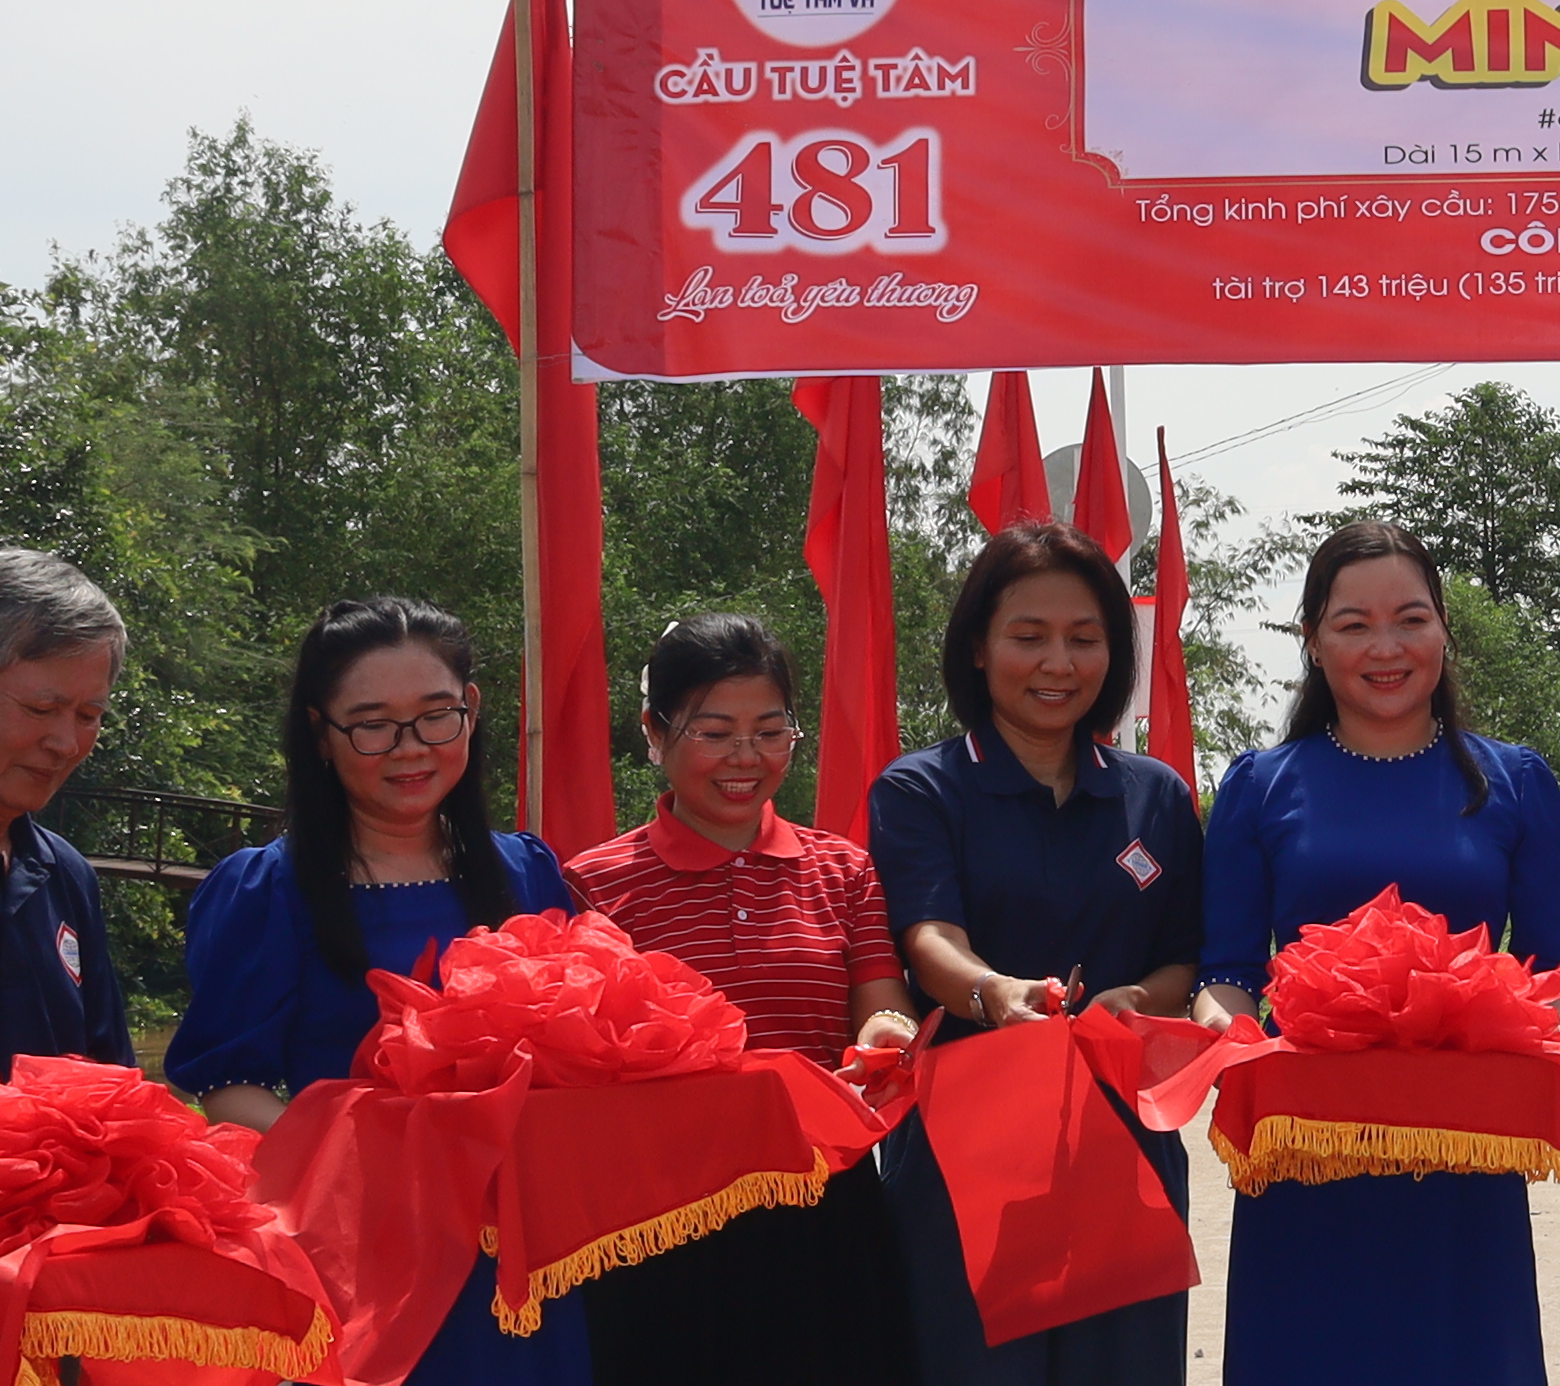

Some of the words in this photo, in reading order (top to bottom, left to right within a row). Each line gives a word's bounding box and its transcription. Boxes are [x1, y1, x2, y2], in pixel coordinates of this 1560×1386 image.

[657, 50, 754, 101] CẦU
[769, 53, 859, 104] TUỆ
[872, 50, 972, 94] TÂM
[1384, 144, 1437, 165] Dài
[1450, 144, 1483, 164] 15
[1493, 147, 1522, 162] m
[1532, 147, 1548, 162] x
[695, 138, 936, 241] 481
[1135, 194, 1213, 226] Tổng
[1224, 197, 1286, 222] kinh
[1298, 194, 1346, 224] phí
[1356, 196, 1409, 222] xây
[1421, 190, 1493, 216] cầu:
[1506, 193, 1559, 216] 175
[781, 277, 860, 323] yêu
[864, 273, 978, 323] thương
[1212, 276, 1253, 300] tài
[1263, 276, 1306, 303] trợ
[1318, 275, 1369, 298] 143
[1379, 273, 1447, 300] triệu
[1458, 272, 1525, 300] (135
